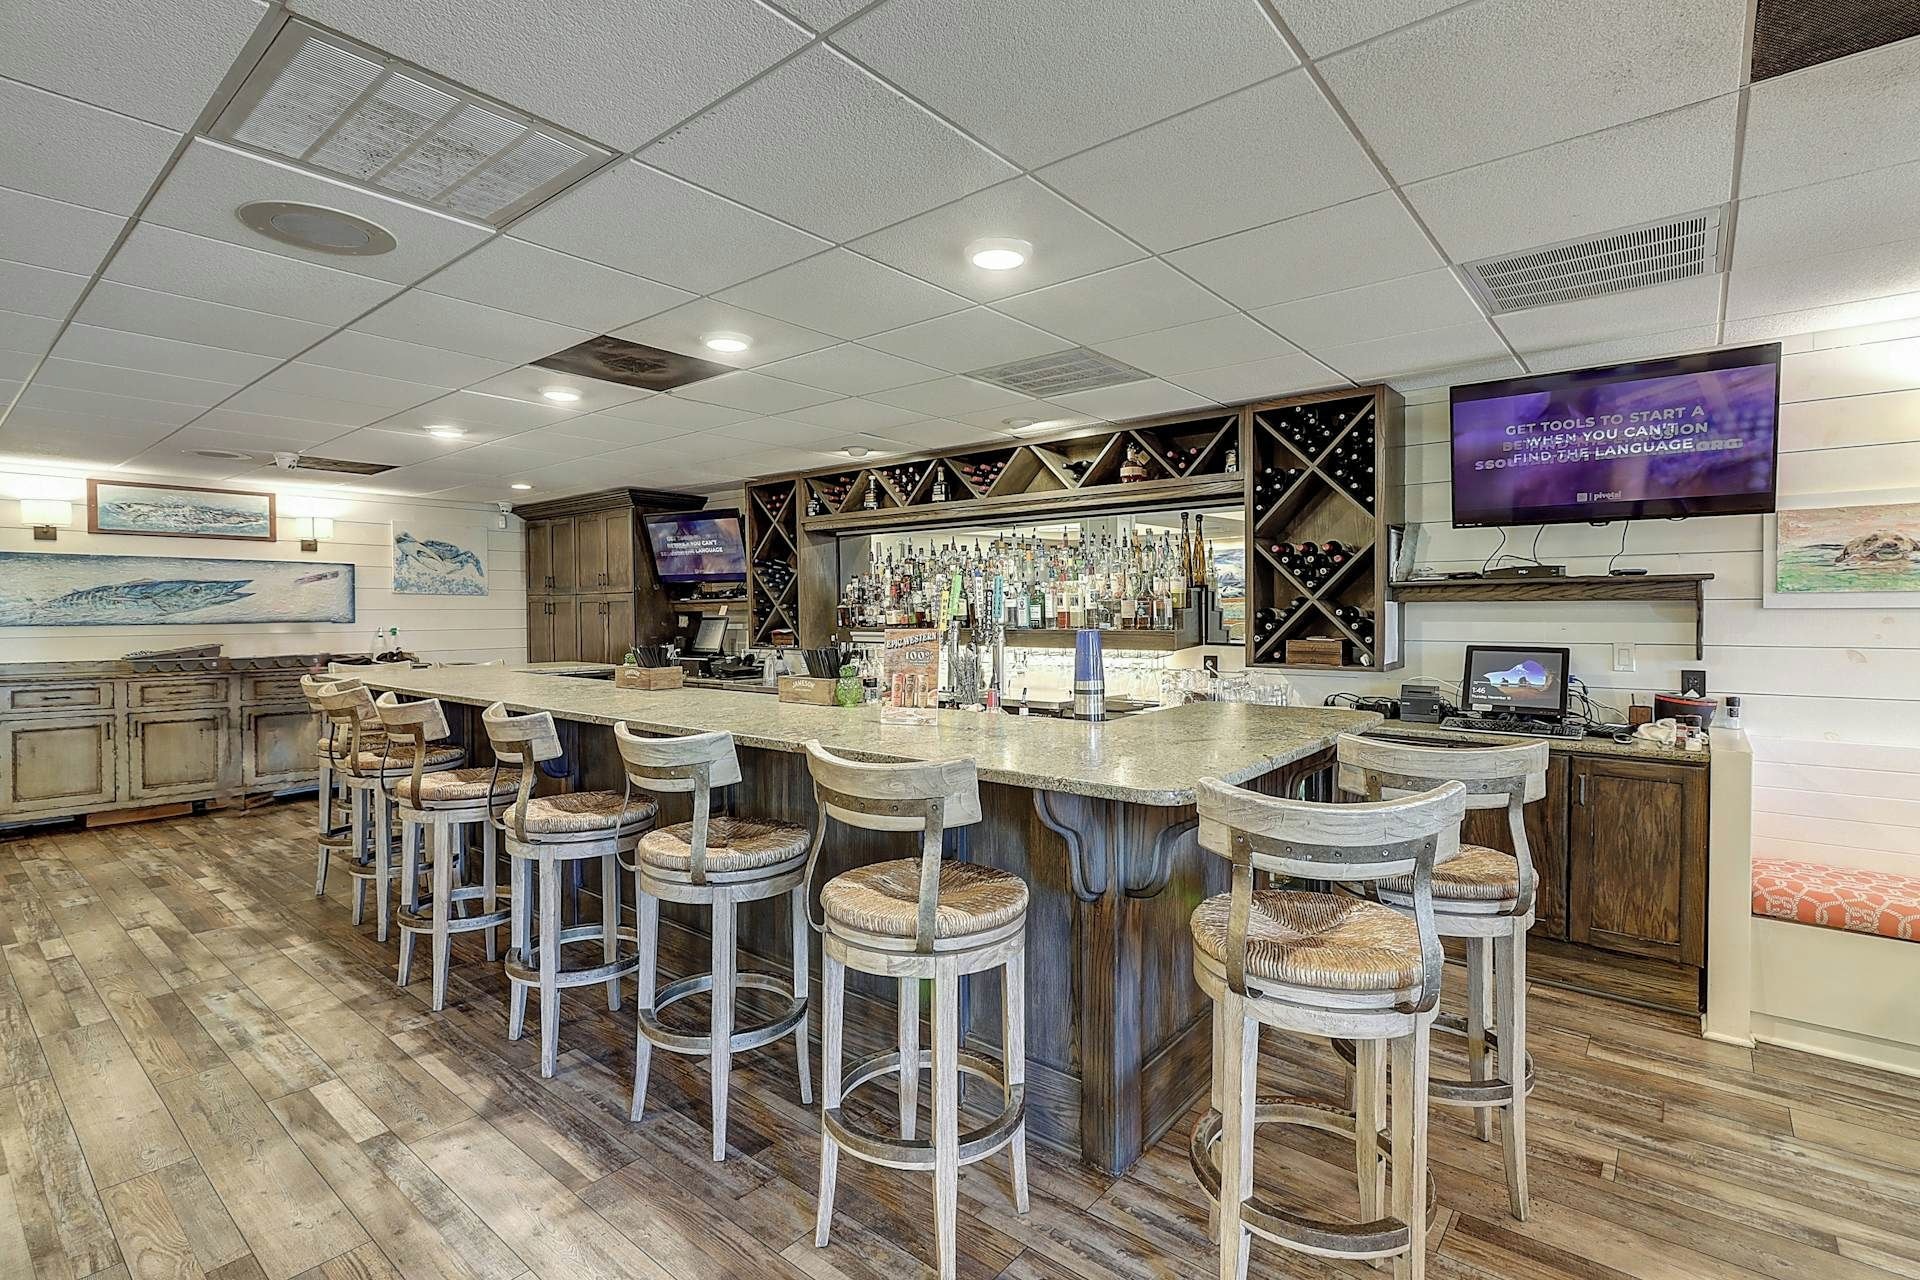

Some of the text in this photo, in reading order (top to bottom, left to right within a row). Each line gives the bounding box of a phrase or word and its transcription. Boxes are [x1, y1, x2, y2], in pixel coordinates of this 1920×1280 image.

[1505, 405, 1705, 436] GET TOOLS TO START A
[1526, 432, 1576, 446] WHEN
[1583, 428, 1618, 441] YOU
[1624, 422, 1678, 438] CAN'T
[1513, 451, 1551, 464] FIND
[1557, 447, 1590, 460] THE
[1595, 437, 1694, 457] LANGUAGE
[904, 631, 938, 647] WESTERN
[905, 651, 934, 661] 100%
[1472, 686, 1486, 694] 1:46
